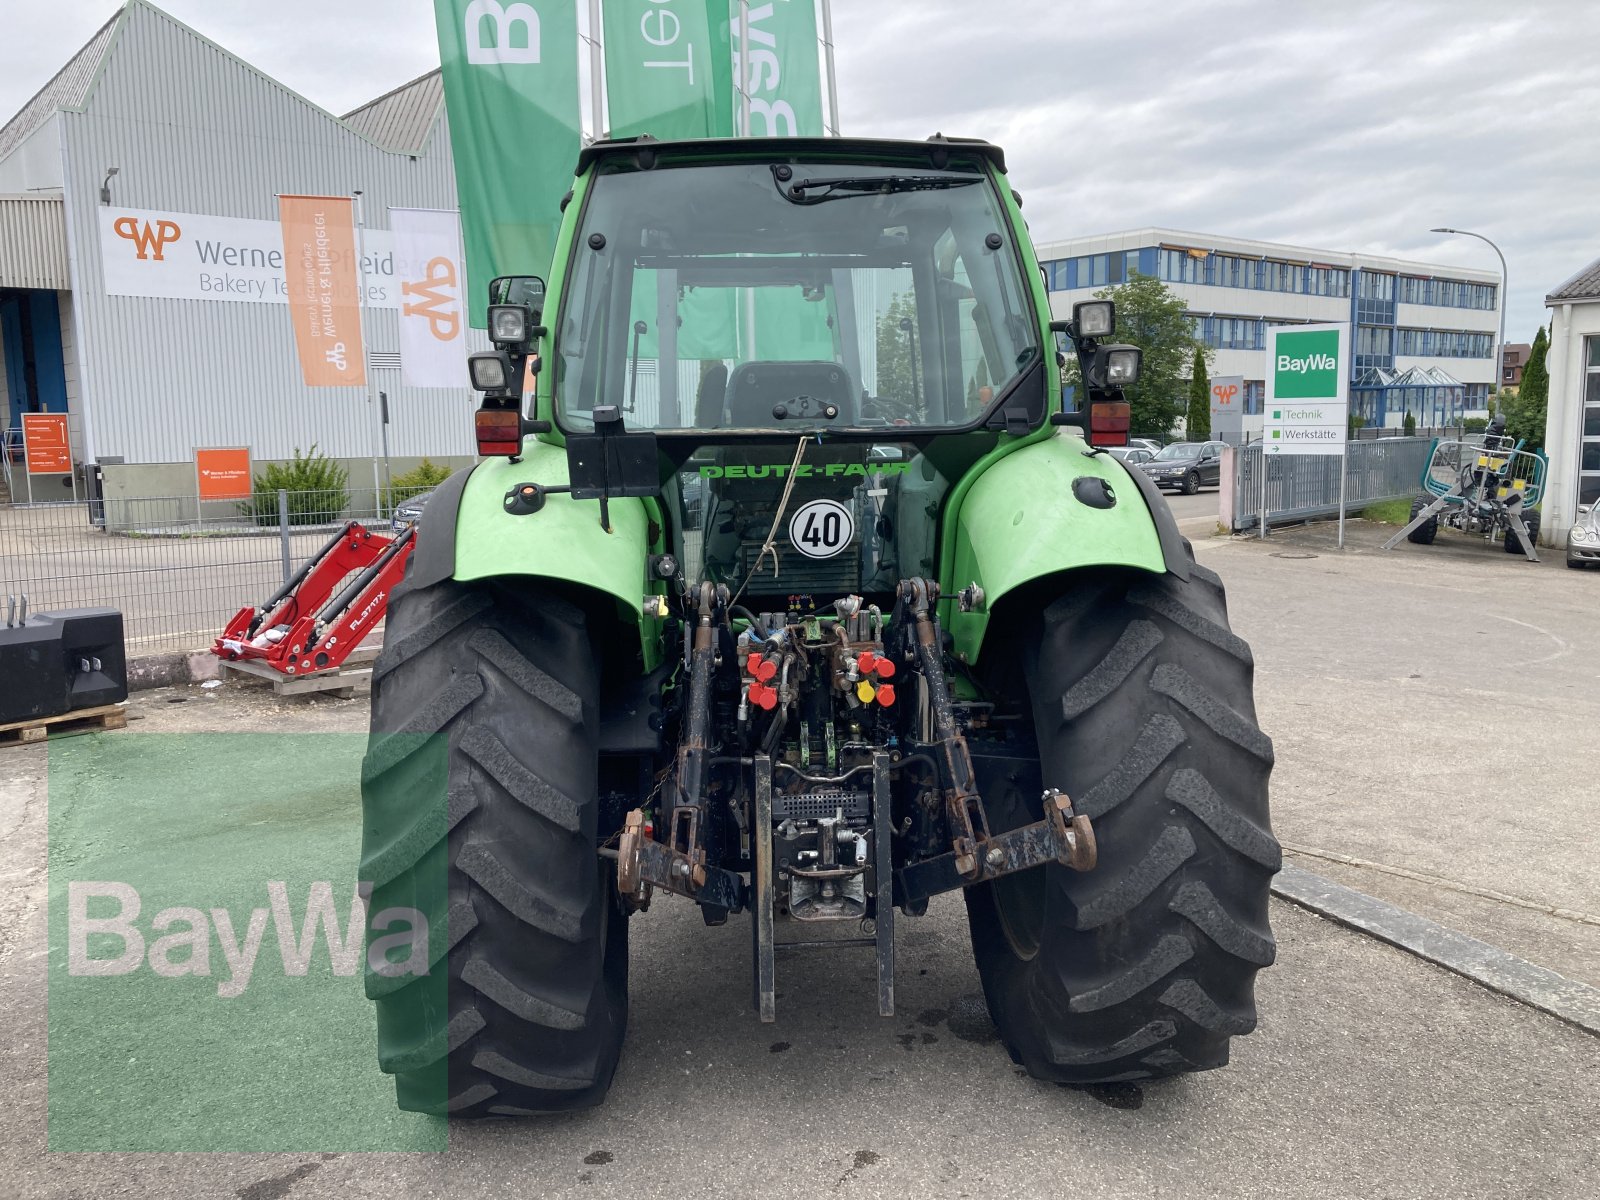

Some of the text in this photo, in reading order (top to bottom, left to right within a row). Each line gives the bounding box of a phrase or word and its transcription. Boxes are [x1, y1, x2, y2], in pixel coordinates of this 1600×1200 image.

[195, 240, 287, 269] Werne
[200, 273, 266, 298] Bakery
[1277, 353, 1336, 374] BayWa
[1285, 409, 1323, 420] Technik
[1284, 430, 1337, 440] Werkstätte
[700, 462, 913, 479] DEUTZ-FAHR
[801, 511, 841, 548] 40
